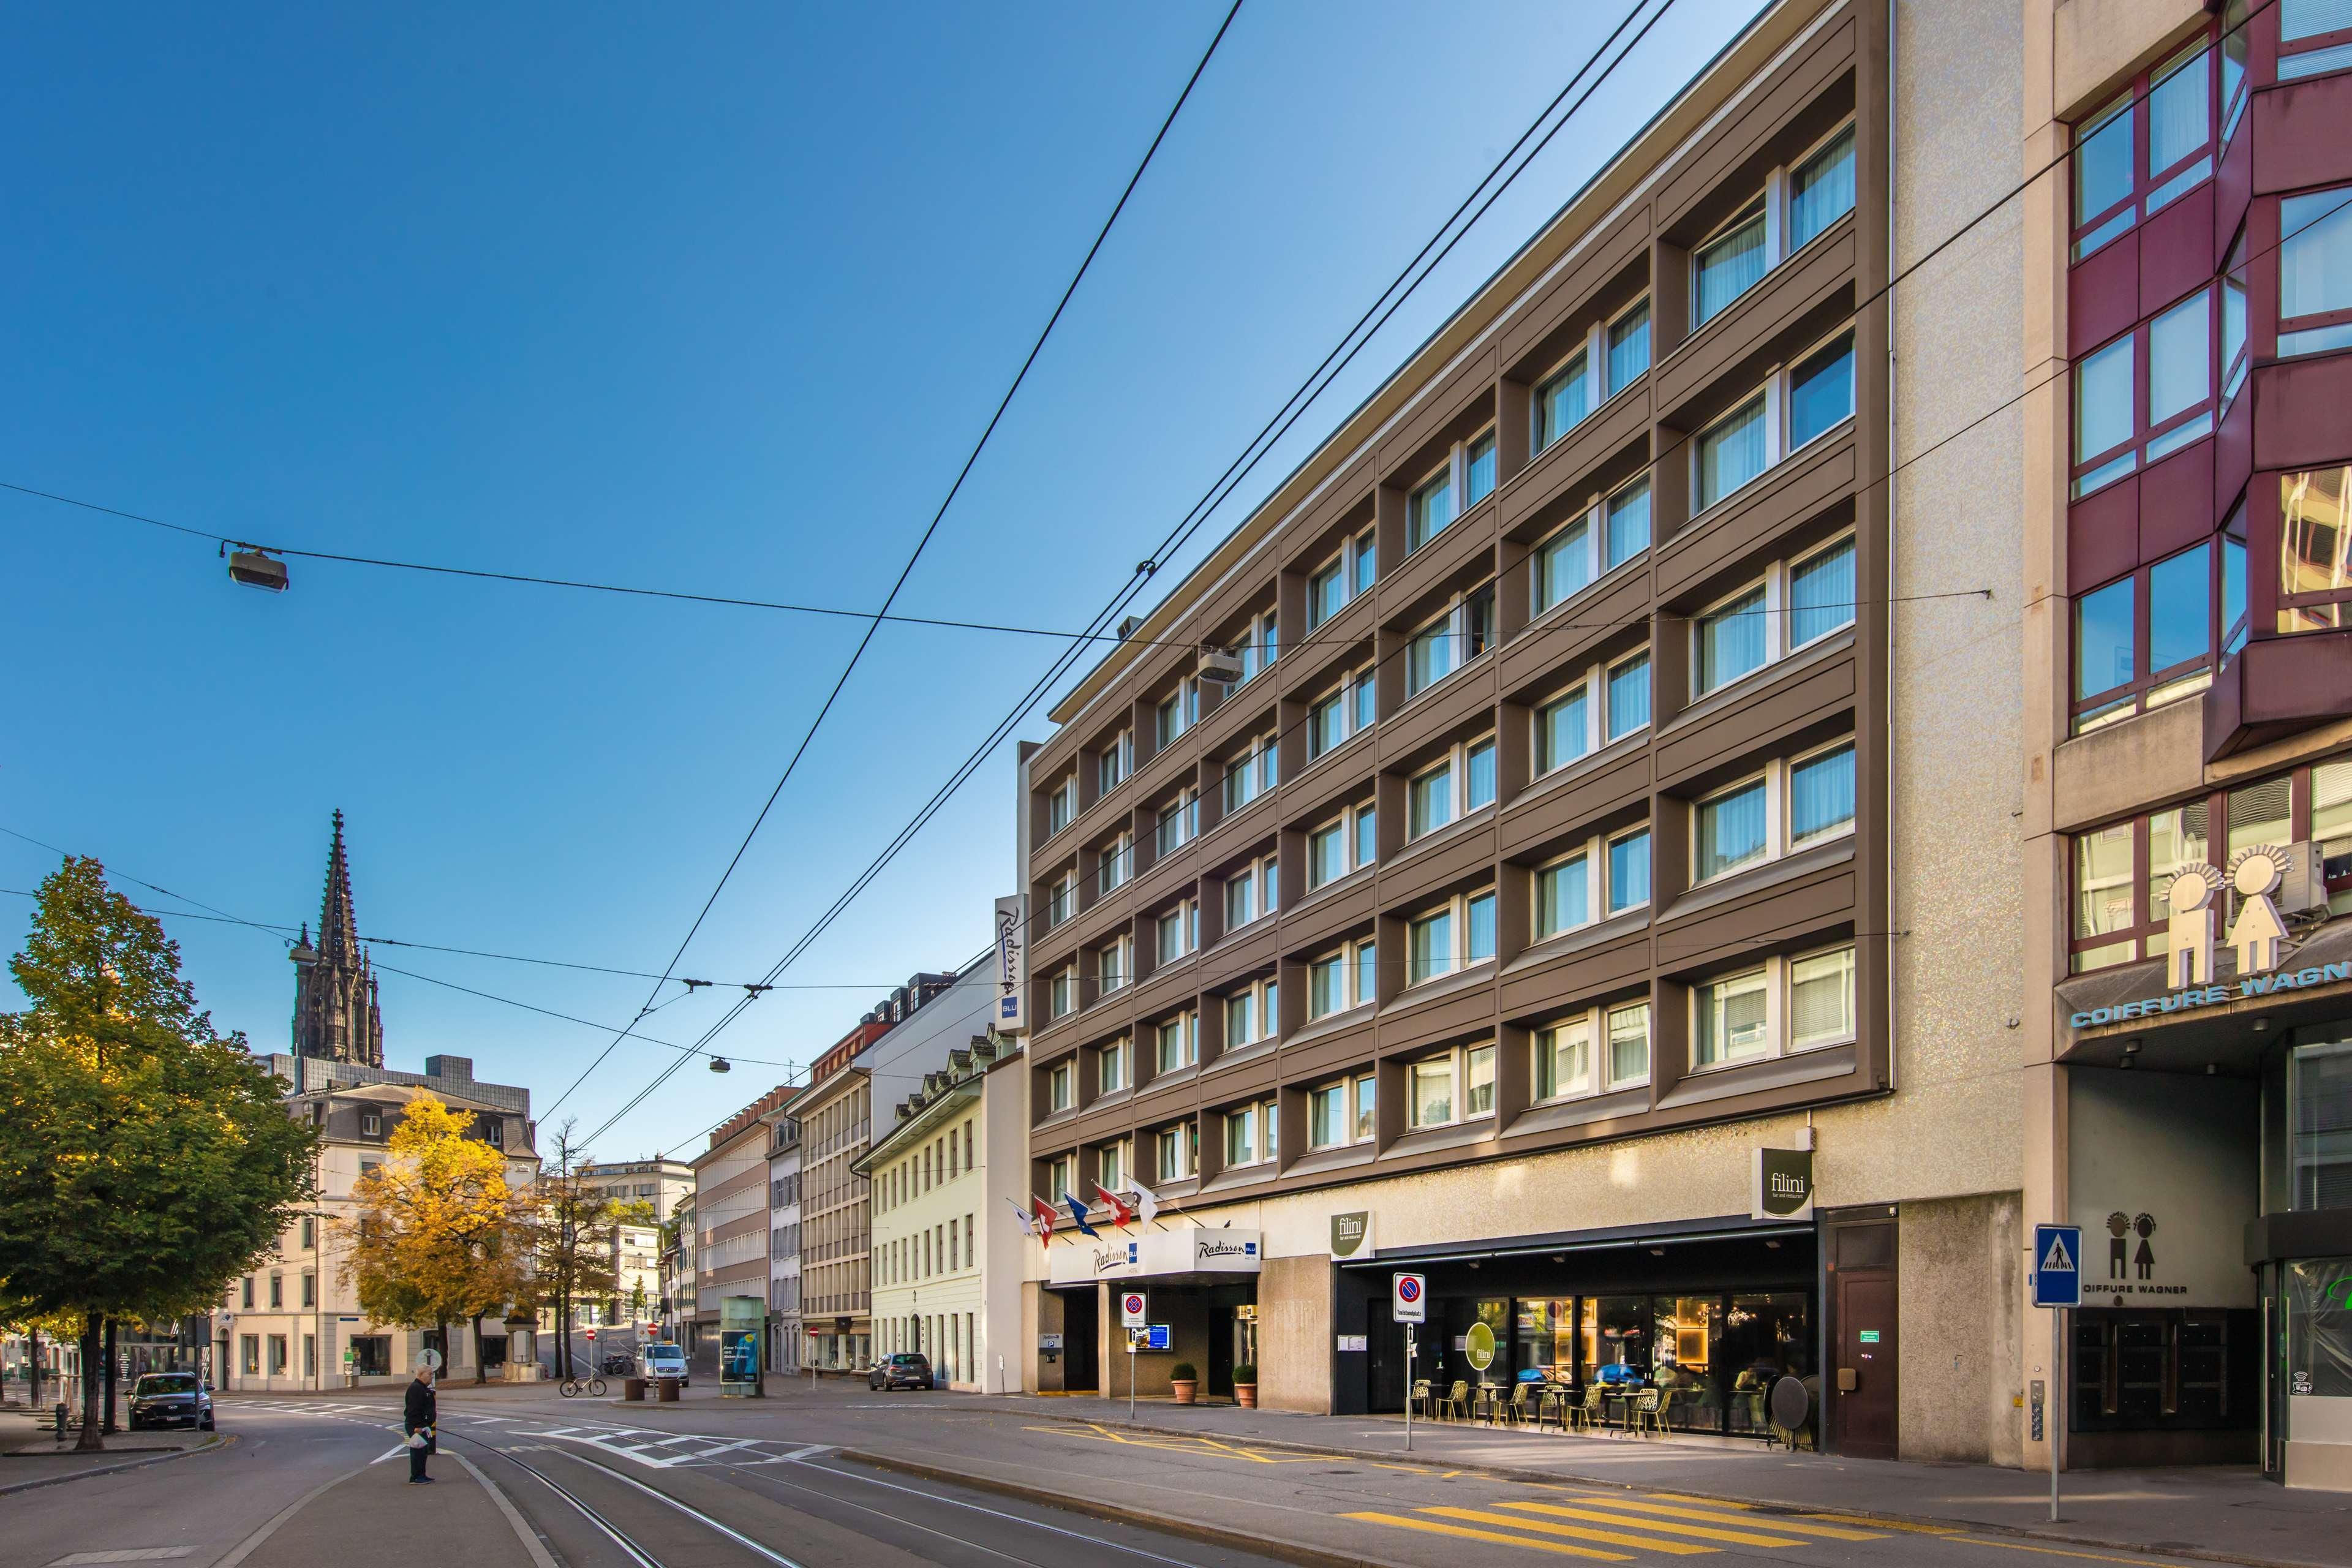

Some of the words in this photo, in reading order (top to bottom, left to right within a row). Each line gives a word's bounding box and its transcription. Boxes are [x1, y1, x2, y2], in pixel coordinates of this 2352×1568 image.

[2070, 986, 2230, 1028] COIFFURE
[2239, 960, 2351, 996] WAGN
[1771, 1172, 1805, 1193] filini
[1339, 1217, 1362, 1235] filini
[1198, 1240, 1245, 1259] Radisson
[1093, 1243, 1128, 1277] Radisson
[2083, 1284, 2133, 1294] OIFFURE
[2138, 1285, 2187, 1294] WAGNER
[1477, 1349, 1490, 1359] filini
